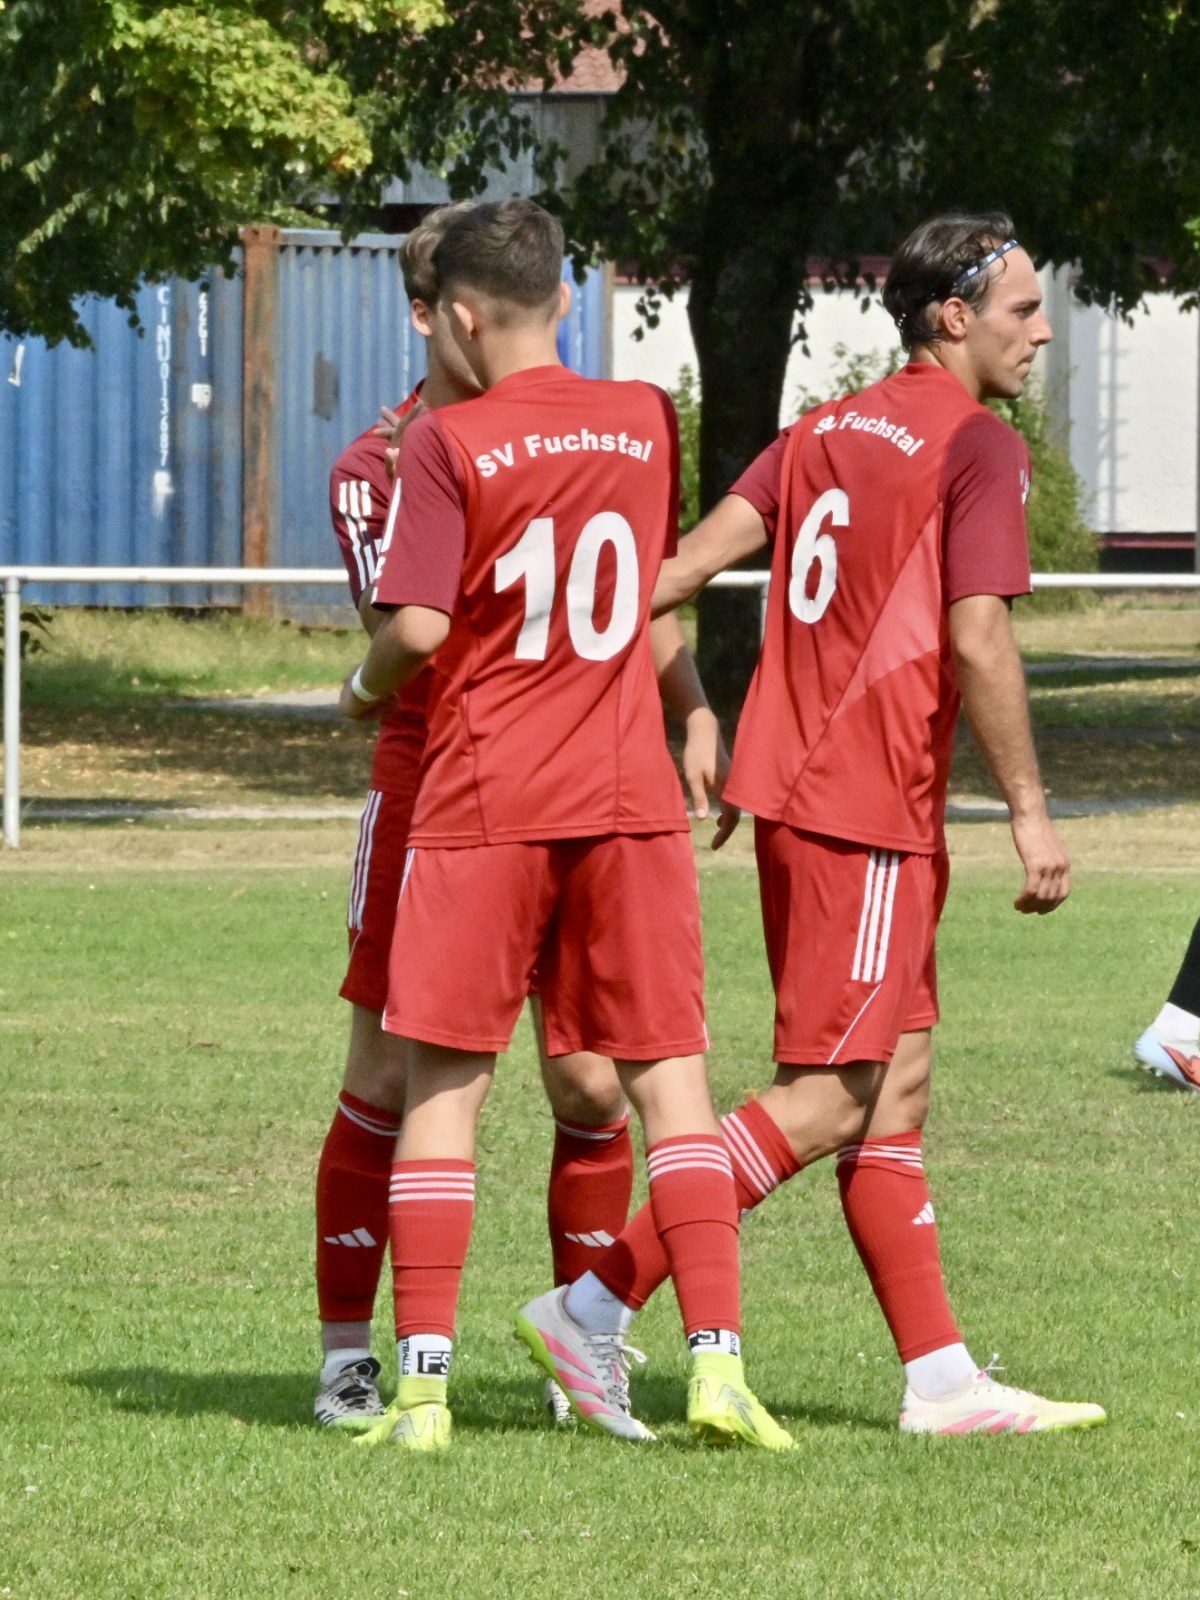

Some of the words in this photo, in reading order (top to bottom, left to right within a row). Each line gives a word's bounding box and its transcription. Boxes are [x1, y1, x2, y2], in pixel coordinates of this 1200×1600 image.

[476, 442, 515, 478] SV
[523, 428, 653, 462] Fuchstal
[839, 411, 925, 456] Fuchstal
[494, 511, 640, 661] 10
[788, 487, 850, 625] 6
